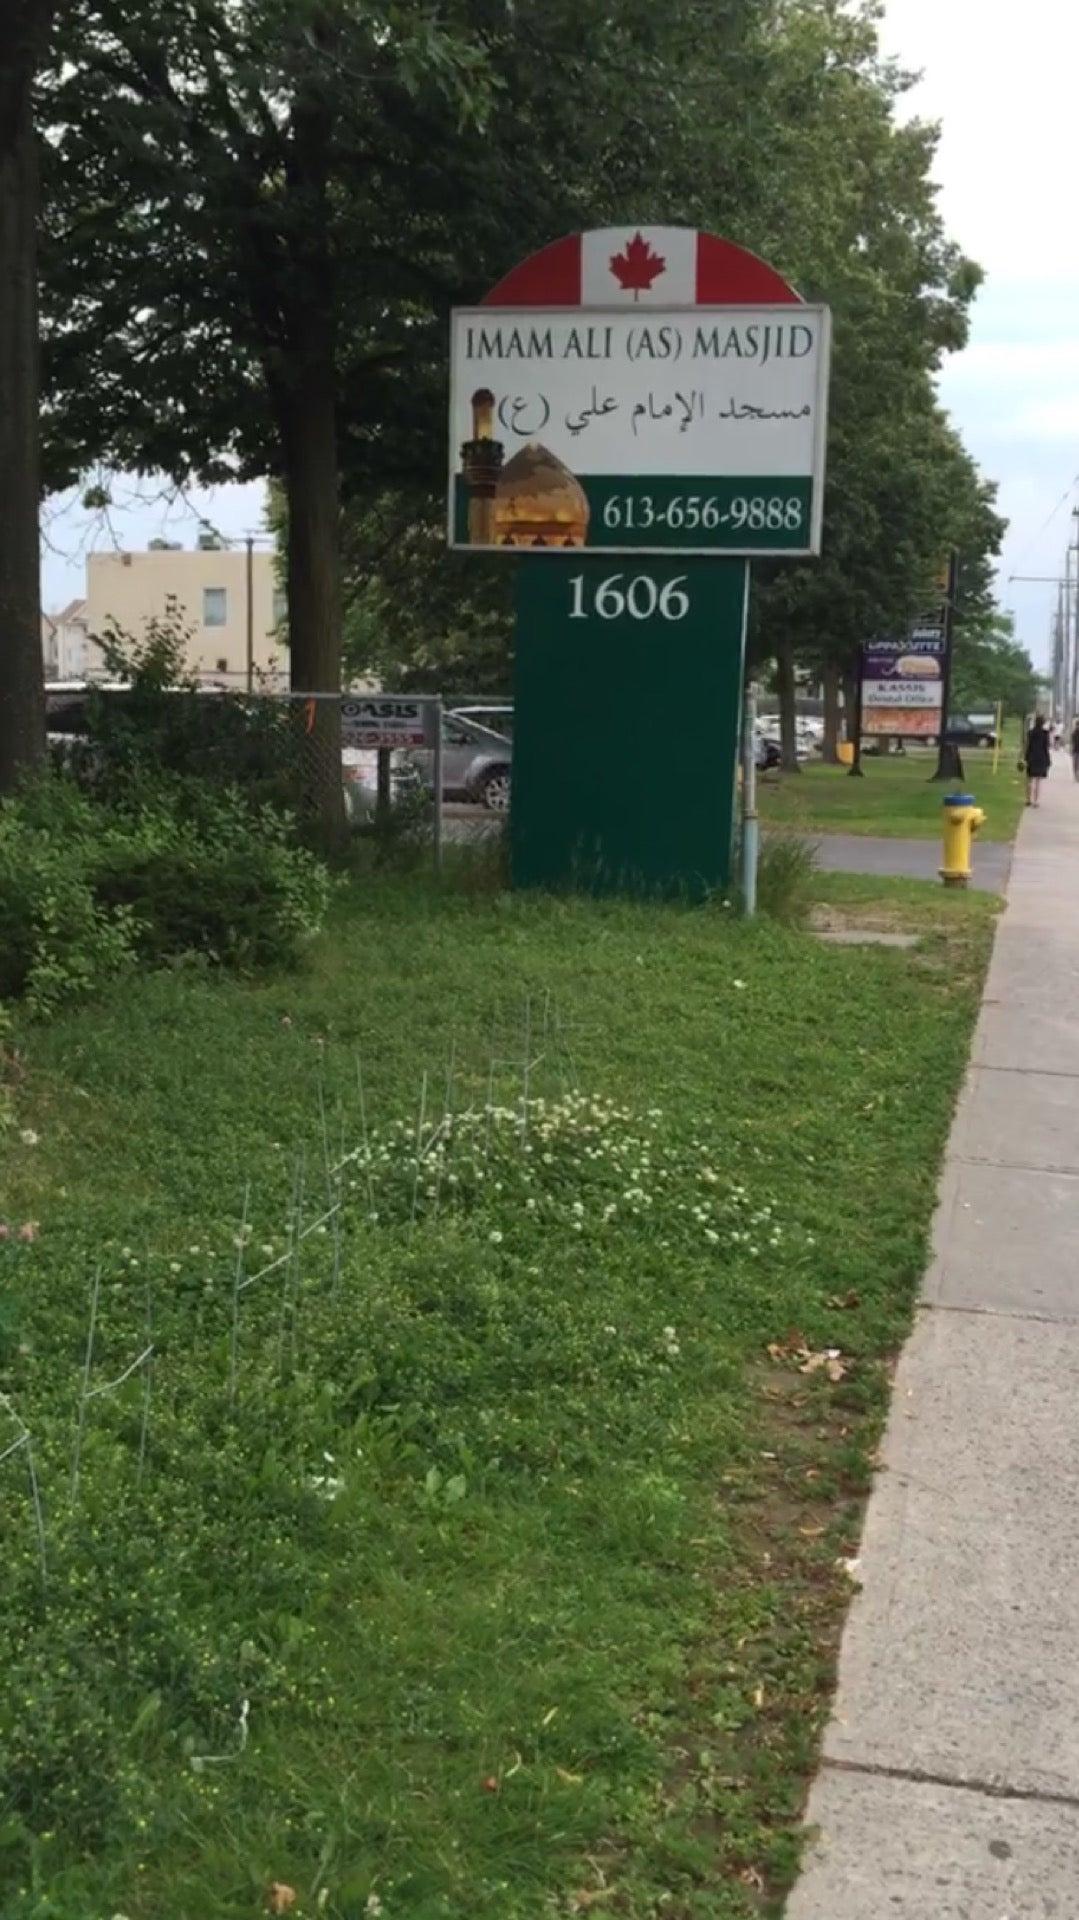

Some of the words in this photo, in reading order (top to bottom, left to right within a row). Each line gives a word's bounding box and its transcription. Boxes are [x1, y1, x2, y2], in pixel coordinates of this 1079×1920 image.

[466, 327, 553, 360] IMAM
[563, 327, 612, 359] ALI
[626, 326, 683, 362] (AS)
[692, 325, 813, 367] MASJID
[498, 393, 551, 436] (ع)
[565, 385, 618, 436] علي
[632, 390, 705, 436] الإمام
[719, 397, 811, 420] مسجد
[603, 496, 802, 531] 613-656-9888
[568, 574, 689, 621] 1606
[341, 703, 418, 719] OASIS
